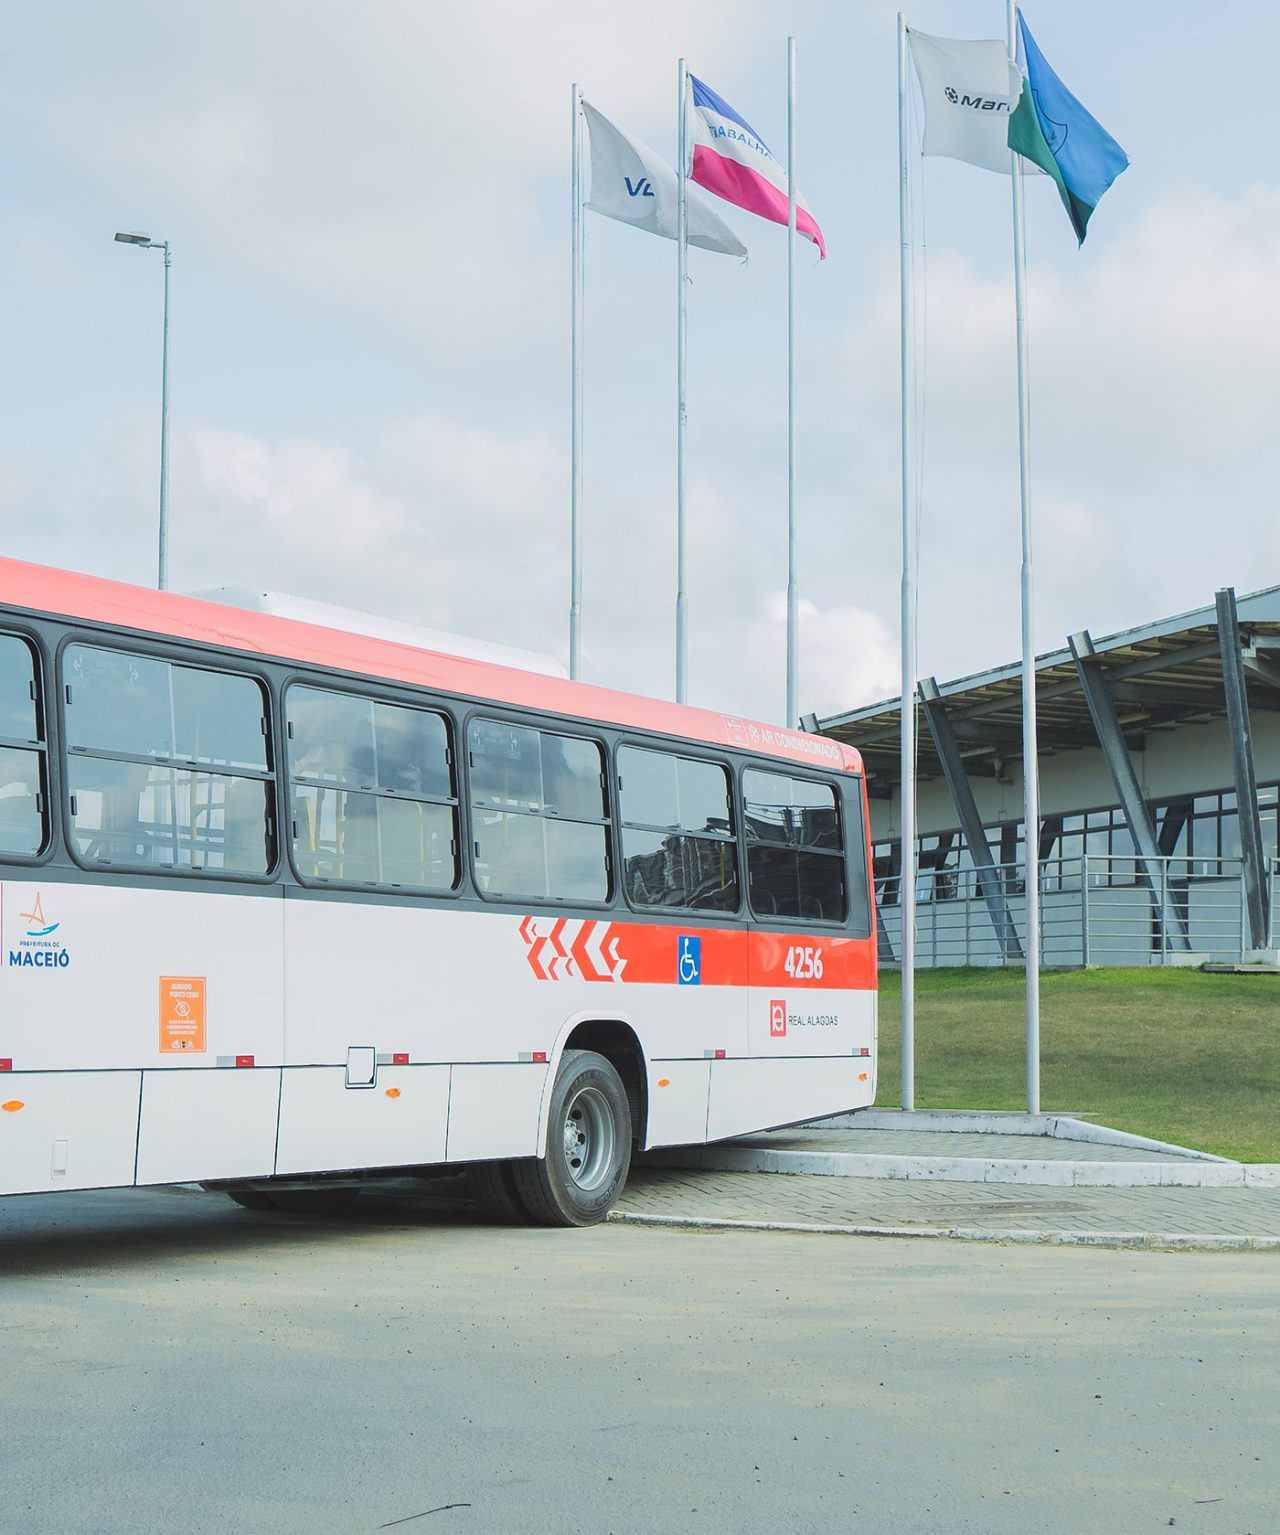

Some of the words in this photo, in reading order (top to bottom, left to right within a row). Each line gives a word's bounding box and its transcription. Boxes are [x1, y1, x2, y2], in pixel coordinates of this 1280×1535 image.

[960, 95, 1010, 112] Mar
[761, 730, 775, 745] AR
[774, 732, 839, 760] CONDICIONADO
[9, 948, 70, 968] MACEIÓ
[784, 946, 824, 979] 4256
[788, 1015, 806, 1026] REAL
[807, 1015, 839, 1026] ALAGOAS
